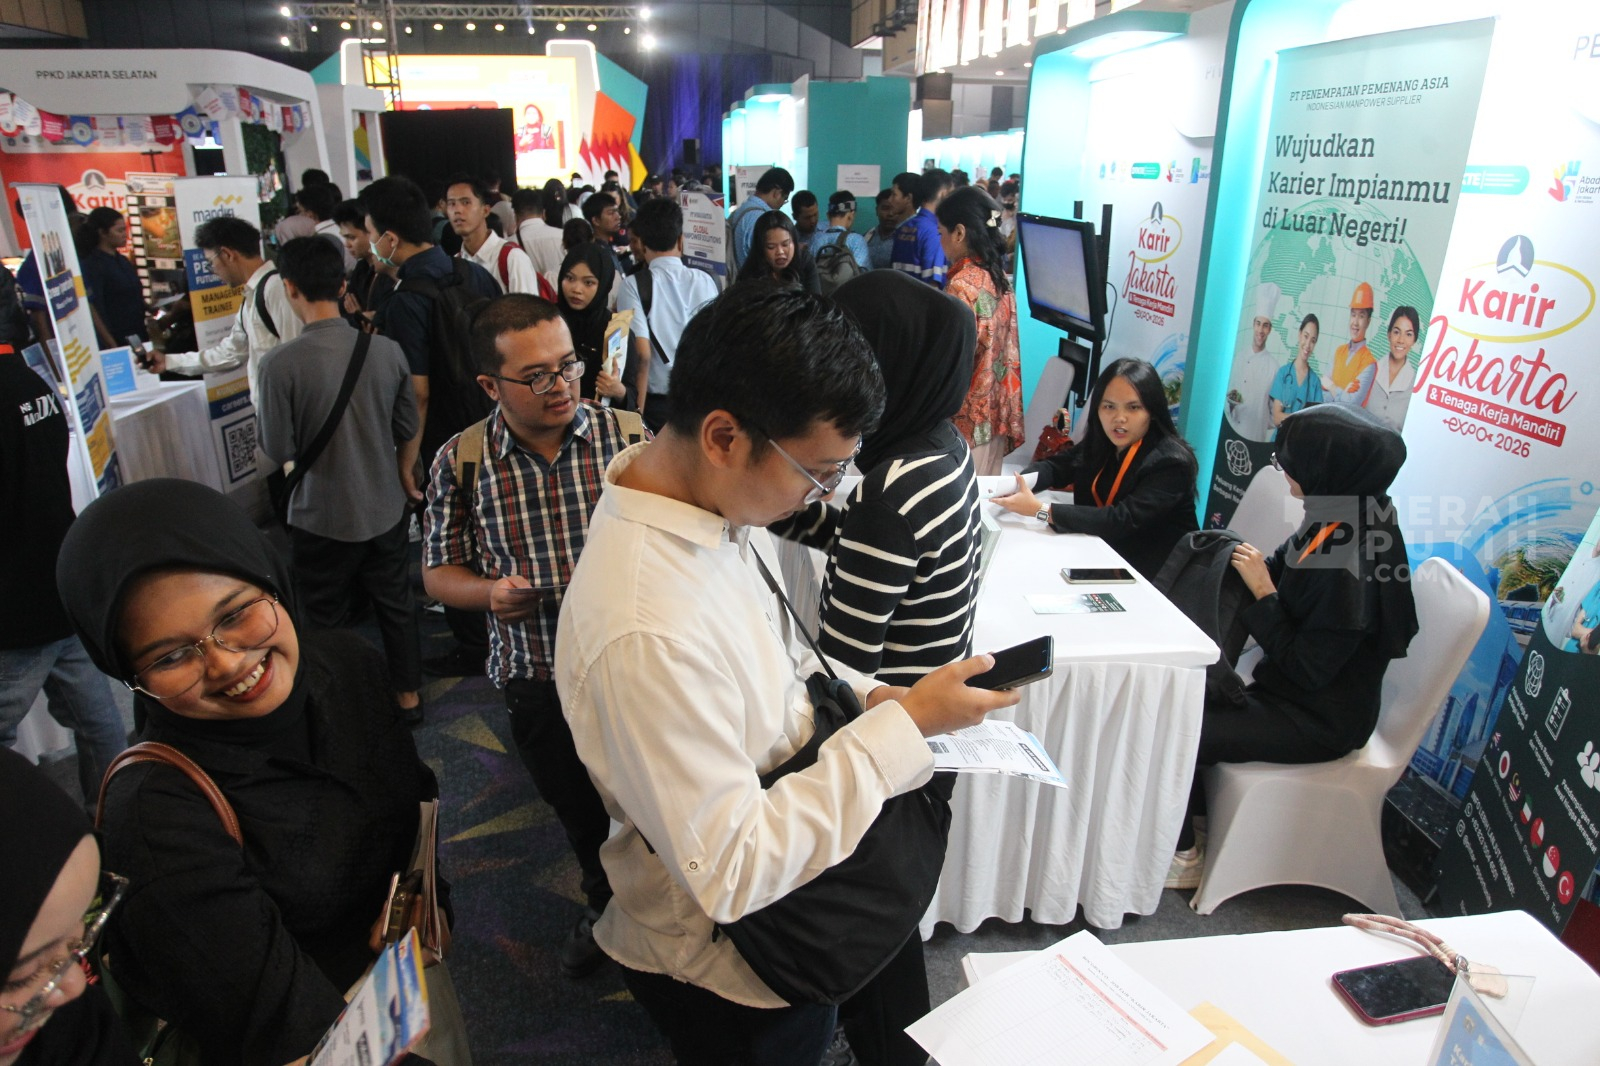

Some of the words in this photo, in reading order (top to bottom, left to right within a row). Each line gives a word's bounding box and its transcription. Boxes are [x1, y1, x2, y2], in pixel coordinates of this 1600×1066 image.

[36, 70, 64, 79] PPKD
[66, 70, 111, 79] JAKARTA
[112, 70, 157, 79] SELATAN
[1289, 91, 1300, 101] PT
[1300, 84, 1360, 100] PENEMPATAN
[1361, 79, 1419, 95] PEMENANG
[1420, 76, 1449, 90] ASIA
[1306, 99, 1345, 111] INDONESIAN
[1345, 96, 1386, 109] MANPOWER
[1386, 94, 1422, 106] SUPPLIER
[1275, 133, 1375, 163] Wujudkan
[71, 191, 125, 210] Karir
[1267, 171, 1326, 196] Karier
[1328, 173, 1451, 205] Impianmu
[1138, 227, 1170, 253] Karir
[1262, 206, 1278, 229] di
[1280, 208, 1327, 235] Luar
[1328, 212, 1407, 246] Negeri!
[1121, 250, 1179, 299] Jakarta
[203, 301, 232, 315] TRAINEE
[1458, 278, 1556, 329] Karir
[1412, 314, 1578, 415] Jakarta
[1429, 387, 1438, 400] &
[1440, 390, 1478, 415] Tenaga
[1479, 403, 1510, 425] Kerja
[1511, 413, 1561, 441] Mandiri
[1494, 433, 1532, 458] 2026
[1562, 778, 1590, 825] Pendampingan
[1576, 818, 1597, 855] Berangkat
